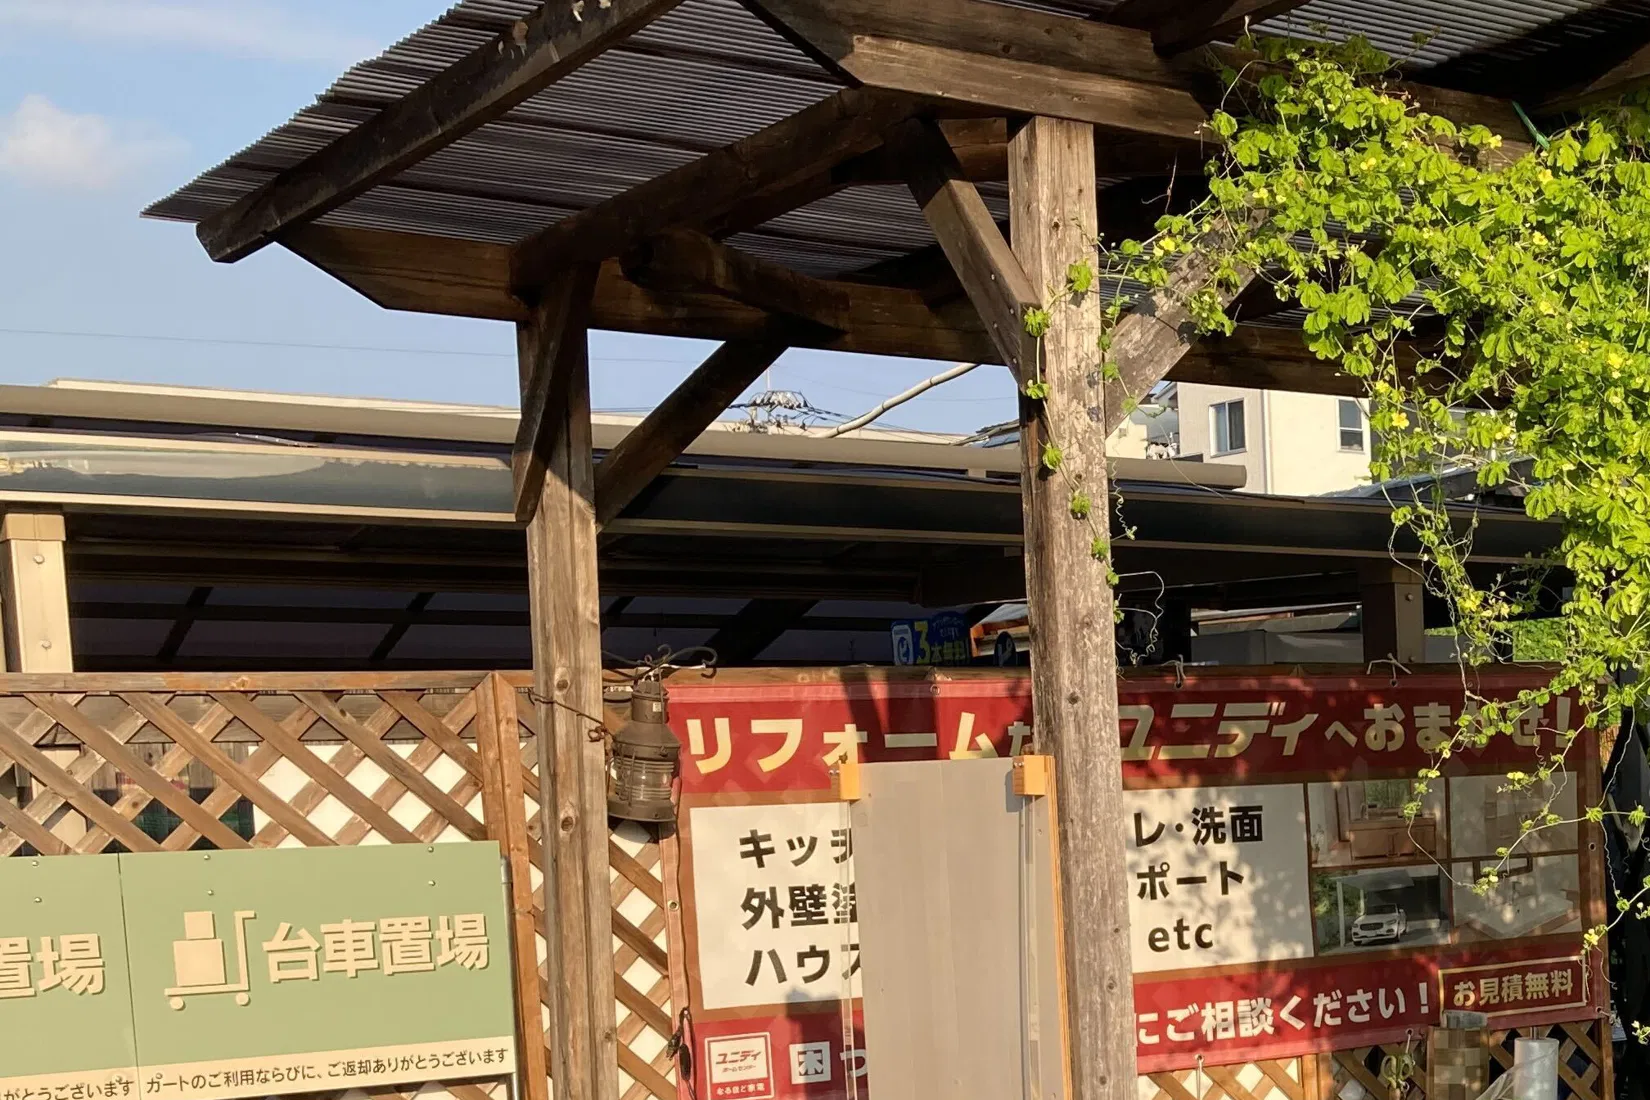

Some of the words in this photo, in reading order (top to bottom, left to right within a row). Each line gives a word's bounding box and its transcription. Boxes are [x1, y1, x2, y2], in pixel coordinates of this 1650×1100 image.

[686, 711, 1033, 775] リフォーム
[1136, 862, 1244, 901] ポート
[261, 912, 491, 984] 台車置場
[1147, 919, 1214, 953] etc
[1453, 967, 1574, 1007] お見積無料
[1134, 982, 1430, 1045] にご相談ください!
[715, 1049, 762, 1065] ユニディ
